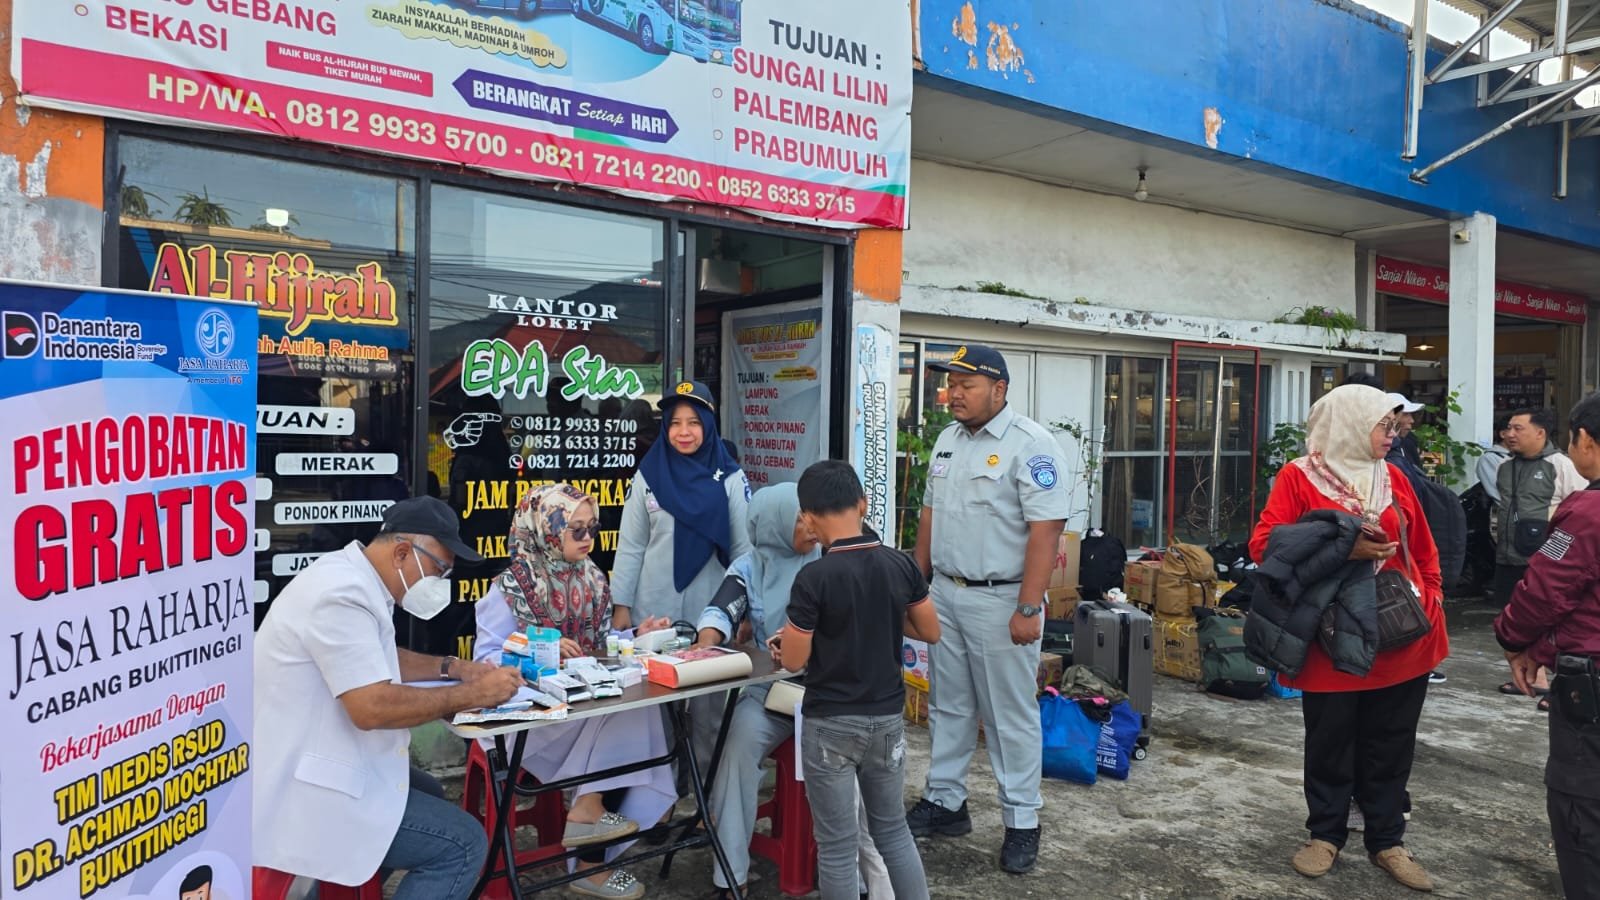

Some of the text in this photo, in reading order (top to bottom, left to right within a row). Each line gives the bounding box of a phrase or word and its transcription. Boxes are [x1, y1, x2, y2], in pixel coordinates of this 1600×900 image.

[105, 4, 228, 51] BEKASI
[371, 9, 555, 59] ZIARAH MAKKAH, MADINAH & UMROH
[405, 5, 526, 42] INSYAALLAH BERHADIAH
[769, 18, 867, 67] TUJUAN
[279, 47, 423, 83] NAIK BUS AL-HIJRAH BUS MEWAH,
[324, 66, 382, 84] TIKET MURAH
[733, 47, 888, 107] SUNGAI LILIN
[472, 79, 667, 135] BERANGKAT Setiap HARI
[734, 87, 878, 141] PALEMBANG
[148, 72, 276, 120] HP/WA.
[286, 99, 360, 133] 0812
[368, 112, 437, 145] 9933
[444, 126, 507, 157] 5700
[530, 142, 584, 170] 0821
[592, 153, 646, 181] 7214
[651, 163, 701, 190] 2200
[717, 175, 763, 200] 0852
[767, 184, 810, 208] 6333
[814, 192, 856, 214] 3715
[734, 127, 888, 178] PRABUMULIH
[151, 243, 398, 336] Al-Hijrah
[1377, 264, 1404, 284] Sanjai
[1403, 269, 1426, 287] Niken
[487, 293, 618, 320] KANTOR
[1503, 289, 1522, 305] Niken
[1526, 294, 1545, 311] Sanjai
[1544, 297, 1561, 312] Niken
[43, 313, 141, 338] Danantara
[517, 315, 593, 331] LOKET
[44, 336, 135, 360] Indonesia
[137, 353, 153, 361] Fund
[278, 335, 325, 357] Aulia
[328, 338, 389, 361] Rahma
[179, 357, 249, 371] JASA RAHARJA
[461, 338, 645, 401] EPA Star
[737, 372, 765, 384] TUJUAN
[744, 387, 779, 400] LAMPUNG
[862, 383, 874, 410] IDUL
[873, 382, 887, 429] BUMN
[744, 404, 770, 416] MERAK
[863, 410, 875, 439] FITRI
[524, 416, 638, 434] 0812 9933 5700
[744, 421, 806, 434] PONDOK PINANG
[13, 414, 247, 495] PENGOBATAN
[524, 435, 637, 451] 0852 6333 3715
[755, 438, 797, 452] RAMBUTAN
[863, 440, 875, 469] 1440
[874, 430, 888, 482] MUDIK
[301, 456, 375, 471] MERAK
[527, 453, 636, 469] 0821 7214 2200
[744, 454, 795, 469] PULO GEBANG
[864, 468, 875, 480] H
[284, 505, 339, 521] PONDOK
[462, 480, 509, 520] JAM
[13, 480, 248, 602] GRATIS
[9, 576, 250, 700] JASA RAHARJA
[27, 634, 242, 724] CABANG BUKITTINGGI
[40, 683, 226, 774] Bekerjasama Dengan
[54, 718, 226, 825] TIM MEDIS RSUD
[13, 742, 250, 890] DR. ACHMAD MOCHTAR
[80, 799, 207, 899] BUKITTINGGI
